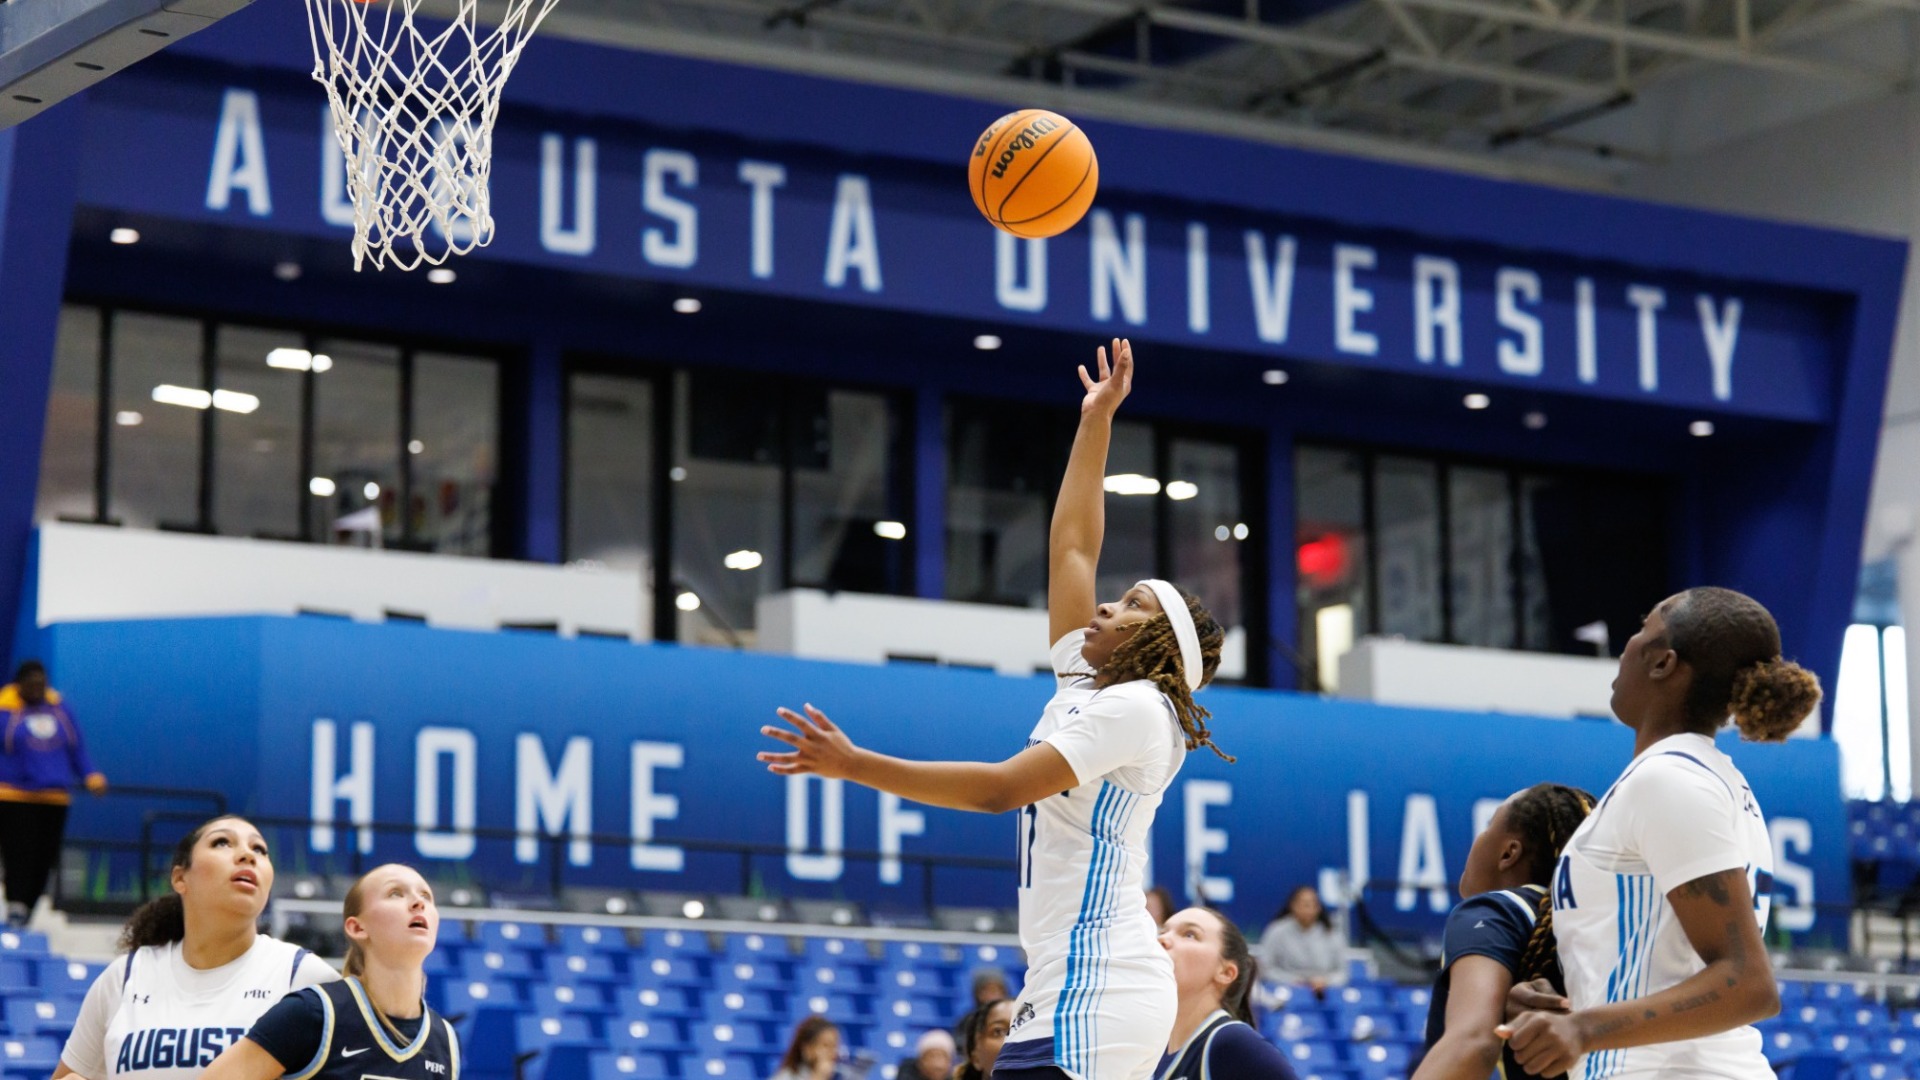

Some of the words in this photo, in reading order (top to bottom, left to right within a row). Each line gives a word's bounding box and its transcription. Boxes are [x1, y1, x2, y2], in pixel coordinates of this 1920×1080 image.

[991, 116, 1060, 179] Wilson
[205, 88, 883, 292] AUGUSTA
[996, 210, 1742, 401] UNIVERSITY
[311, 718, 684, 872] HOME
[785, 772, 925, 884] OF
[116, 1027, 245, 1074] AUGUST
